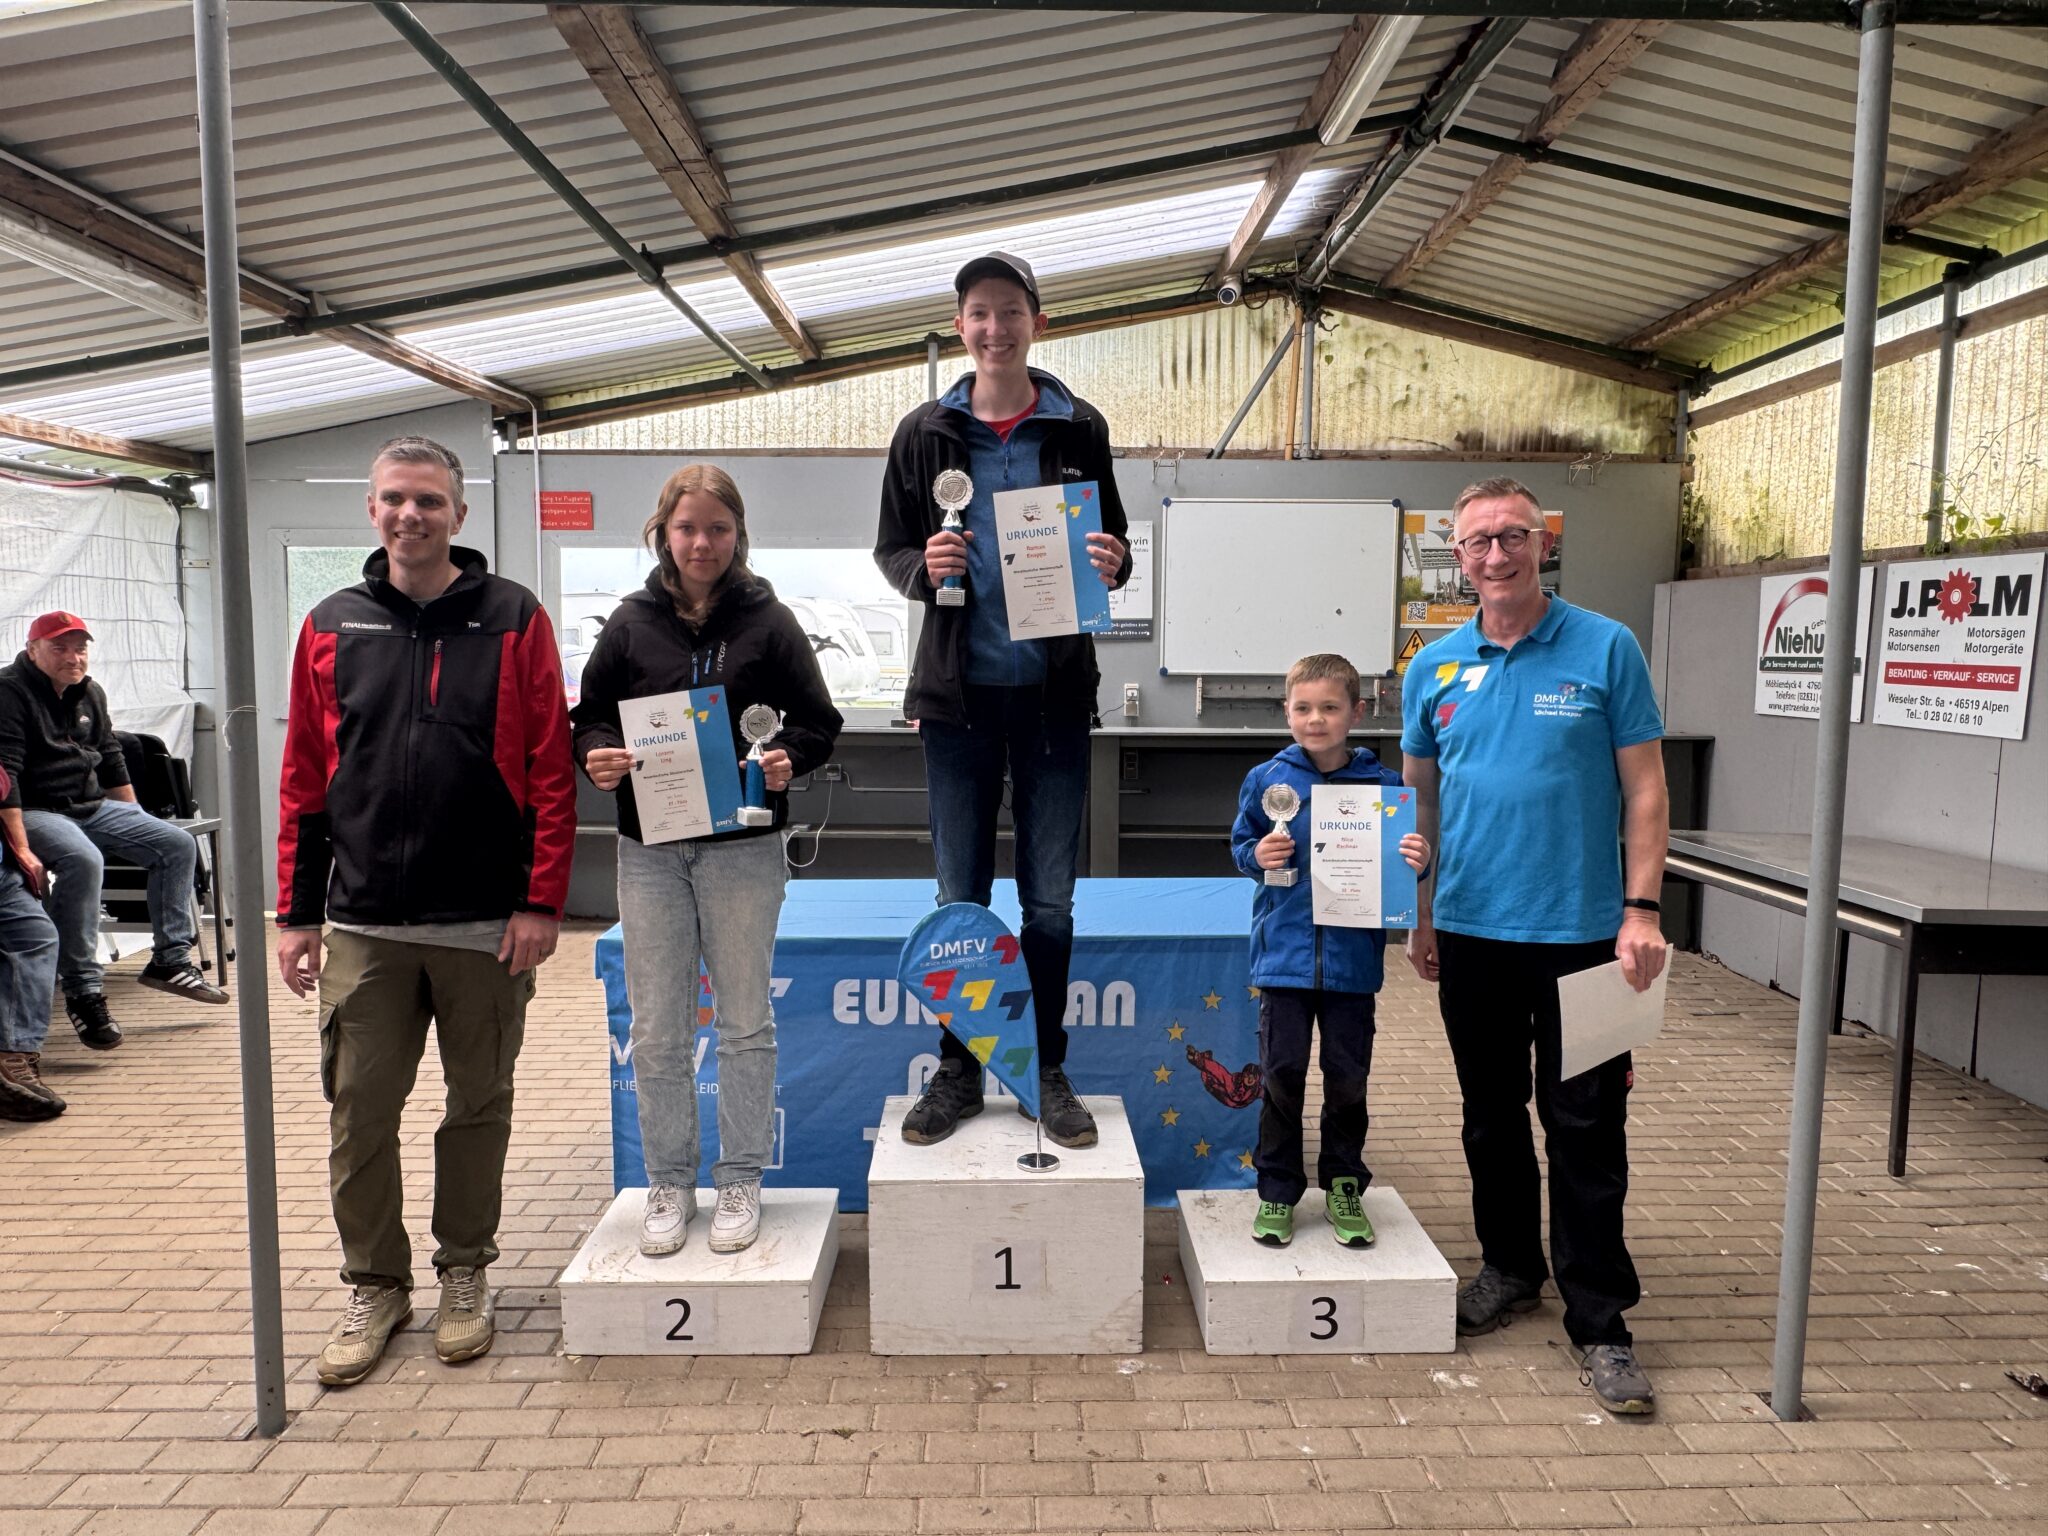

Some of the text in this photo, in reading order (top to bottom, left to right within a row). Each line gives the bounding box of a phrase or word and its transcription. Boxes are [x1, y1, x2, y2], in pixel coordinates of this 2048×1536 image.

[1007, 526, 1058, 540] URKUNDE
[1775, 626, 1825, 654] Niehu
[1888, 627, 2026, 641] Rasenmäher Motorsägen
[1887, 641, 2024, 656] Motorsensen Motorgeräte
[1888, 668, 1928, 680] BERATUNG
[1933, 669, 1971, 682] VERKAUF
[1976, 672, 2015, 685] SERVICE
[1807, 681, 1821, 690] 4760
[1534, 694, 1567, 704] DMFV
[1888, 693, 2009, 715] Weseler Str. 6a 46519 Alpen
[1906, 708, 1922, 720] Tel.:
[1924, 711, 1929, 721] 0
[1930, 711, 1940, 721] 28
[1942, 712, 1952, 723] 02
[1959, 713, 1970, 724] 68
[1973, 715, 1983, 726] 10
[633, 731, 688, 748] URKUNDE
[1320, 821, 1372, 831] URKUNDE
[930, 938, 987, 959] DMFV
[993, 1246, 1022, 1290] 1
[664, 1297, 694, 1342] 2
[1310, 1296, 1339, 1340] 3
